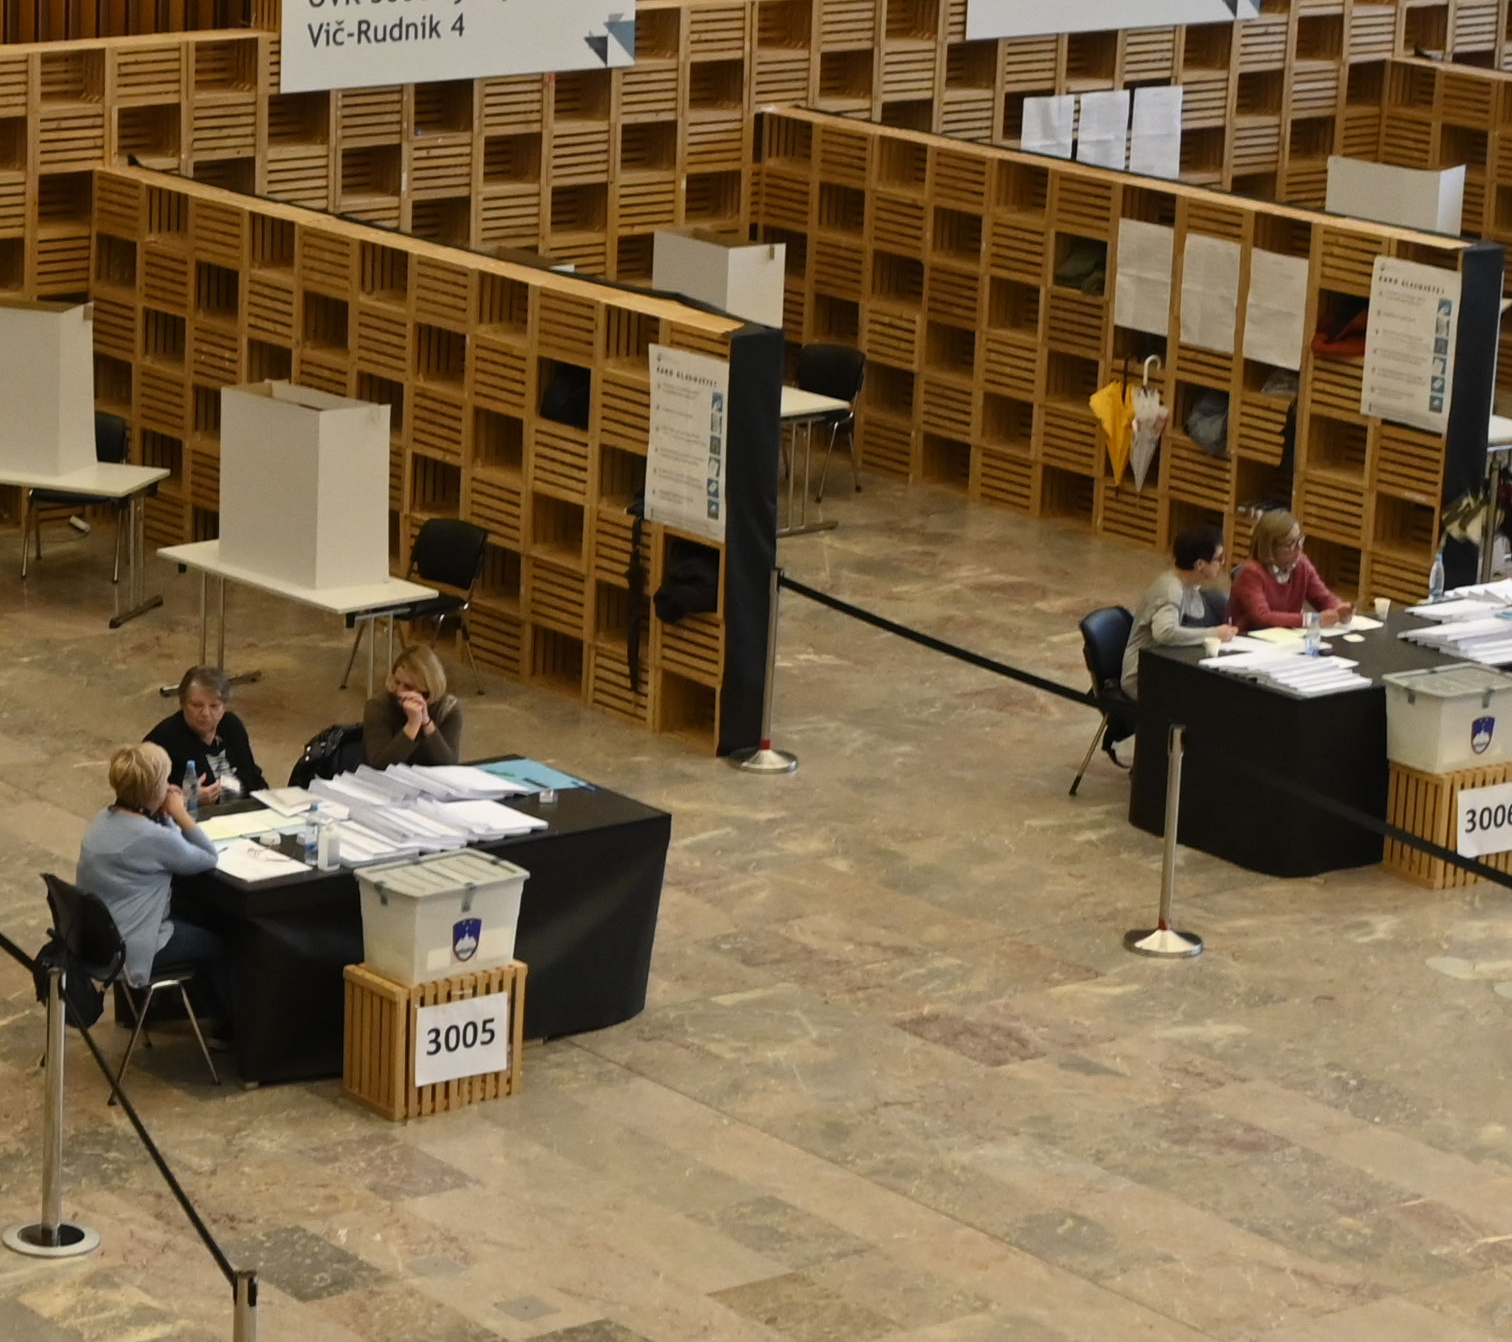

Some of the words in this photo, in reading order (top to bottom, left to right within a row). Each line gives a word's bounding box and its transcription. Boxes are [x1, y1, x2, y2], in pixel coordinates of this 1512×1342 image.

[307, 13, 442, 48] Vič-Rudnik
[450, 12, 465, 37] 4
[426, 1017, 496, 1056] 3005
